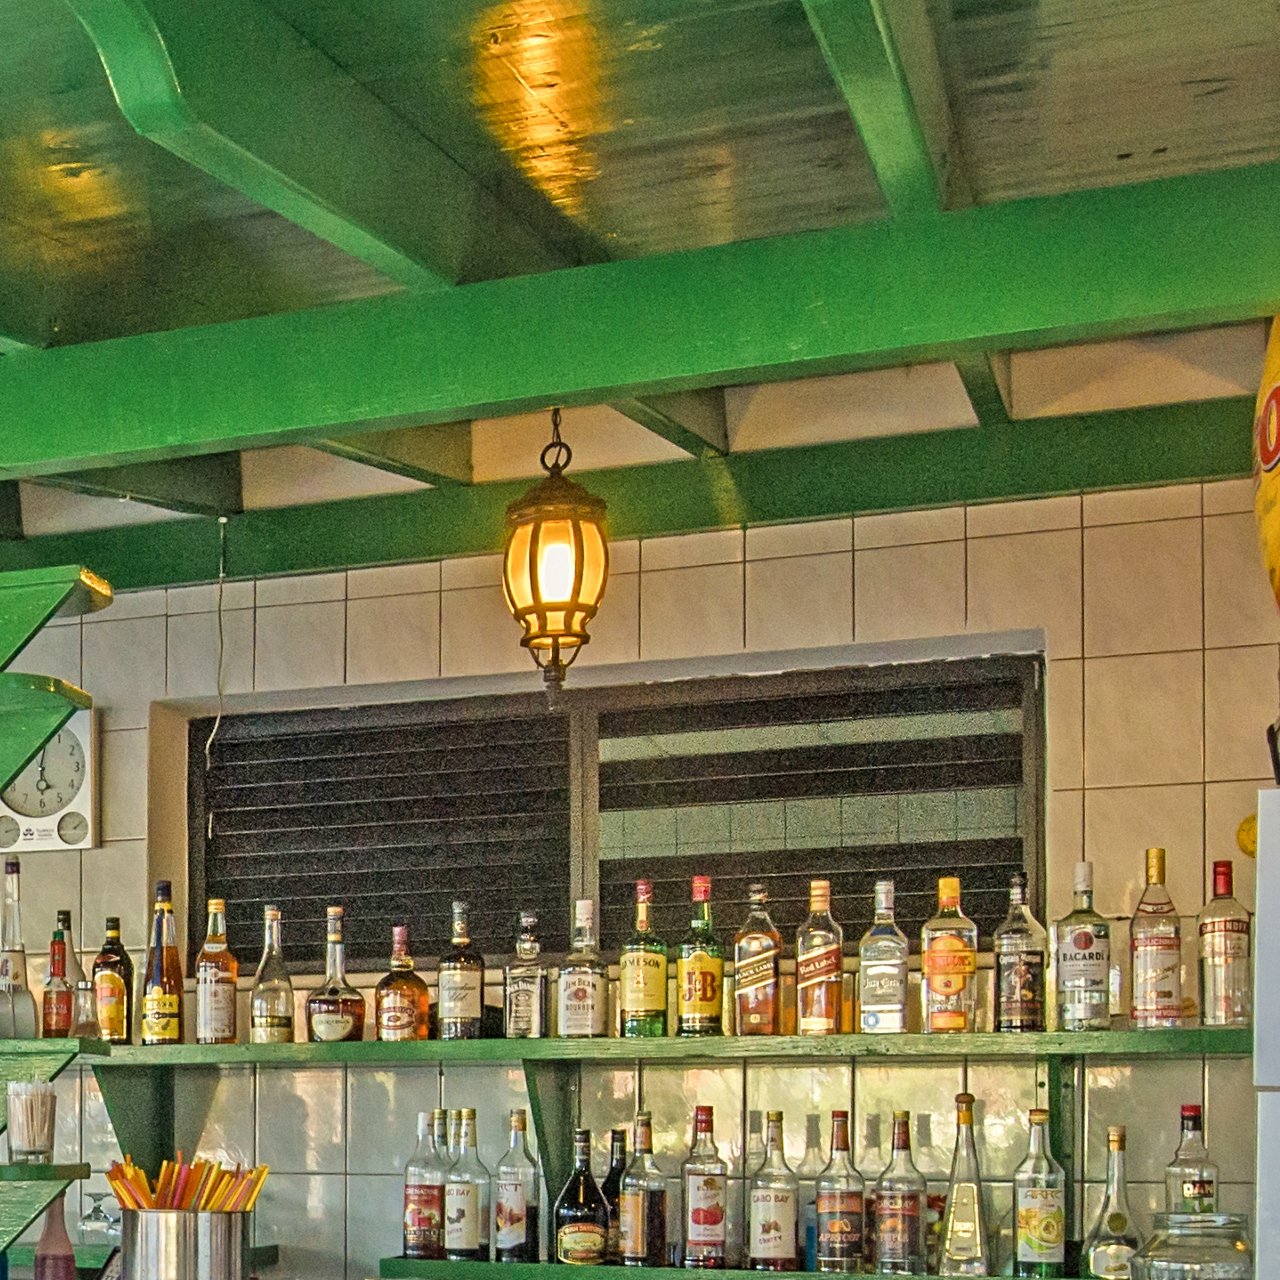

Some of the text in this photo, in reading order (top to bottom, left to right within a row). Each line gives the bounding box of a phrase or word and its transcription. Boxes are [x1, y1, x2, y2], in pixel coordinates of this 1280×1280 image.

[800, 956, 837, 975] Red Label
[774, 1194, 790, 1202] BAY
